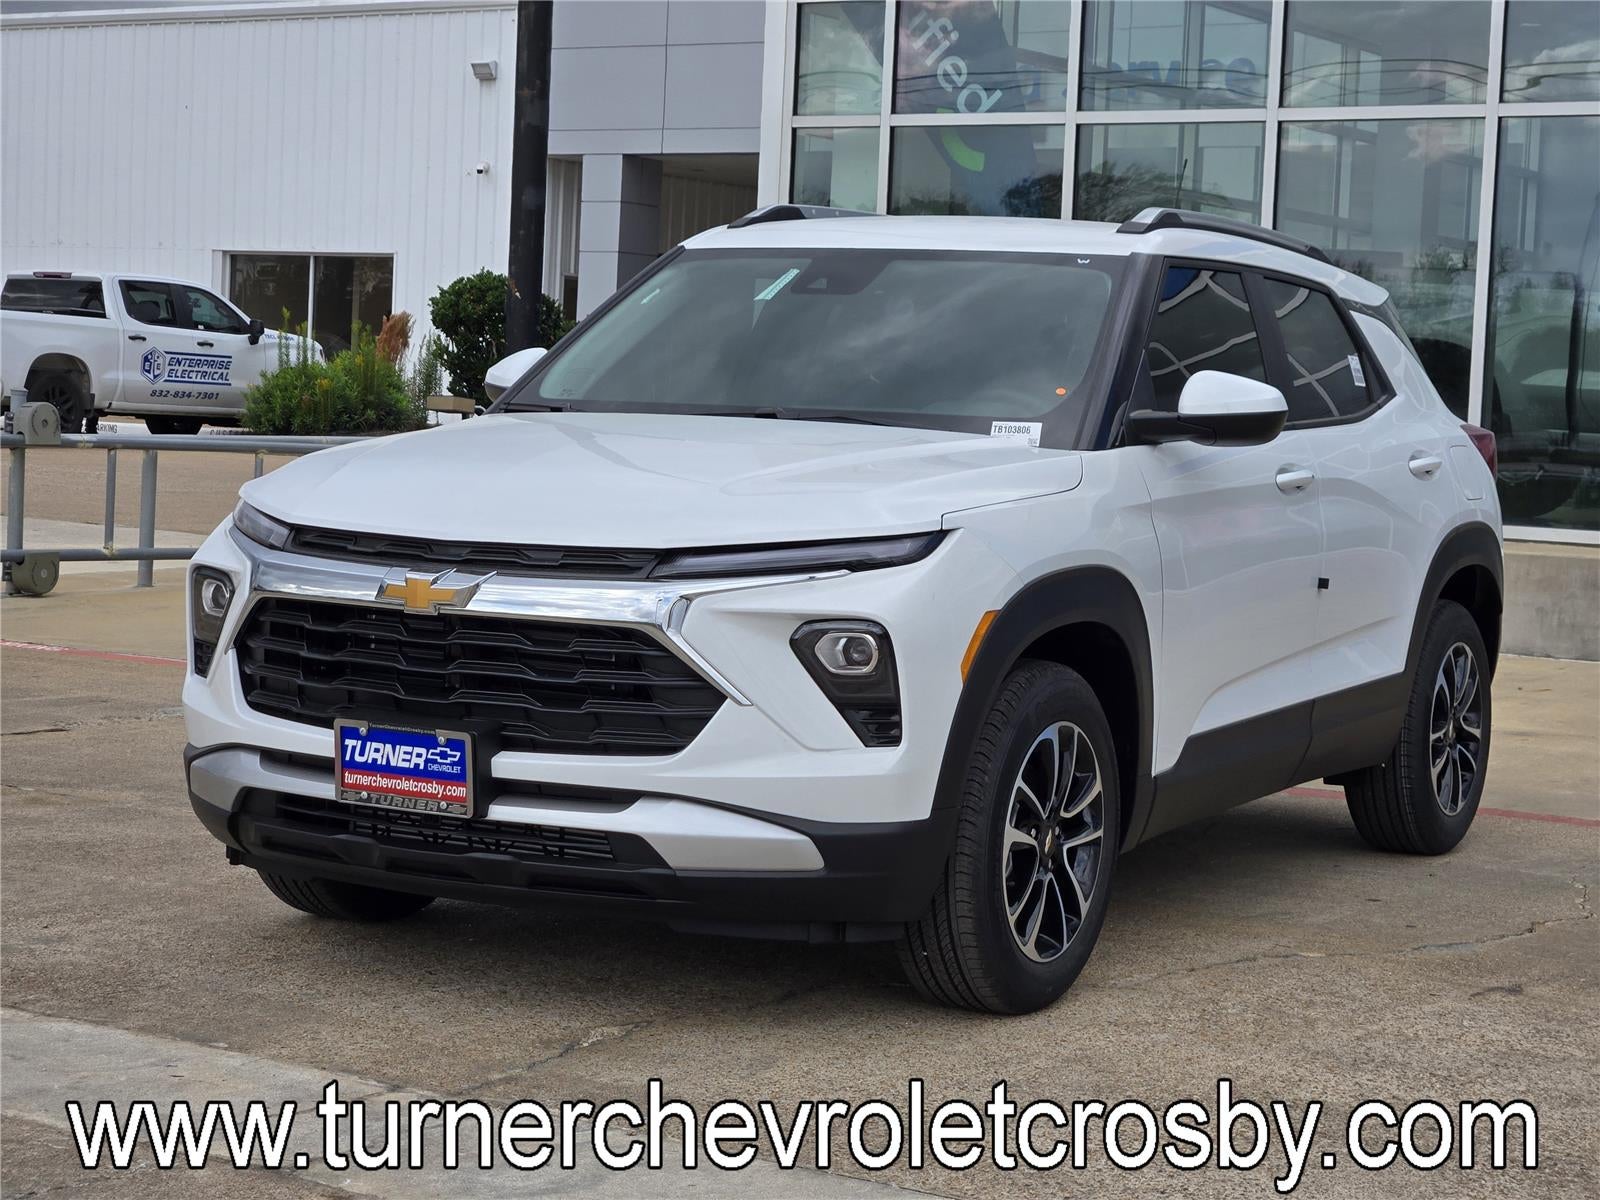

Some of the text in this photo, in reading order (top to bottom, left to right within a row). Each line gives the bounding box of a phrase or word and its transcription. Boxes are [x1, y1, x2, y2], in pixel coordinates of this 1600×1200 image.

[167, 357, 233, 370] ENTERPRISE
[167, 369, 230, 382] ELECTRICAL
[150, 389, 220, 400] 832-834-7301
[344, 738, 427, 770] TURNER
[427, 763, 461, 774] CHEVROLET
[344, 770, 467, 798] turnerchevroletcrosby.com
[369, 793, 439, 812] TURNER
